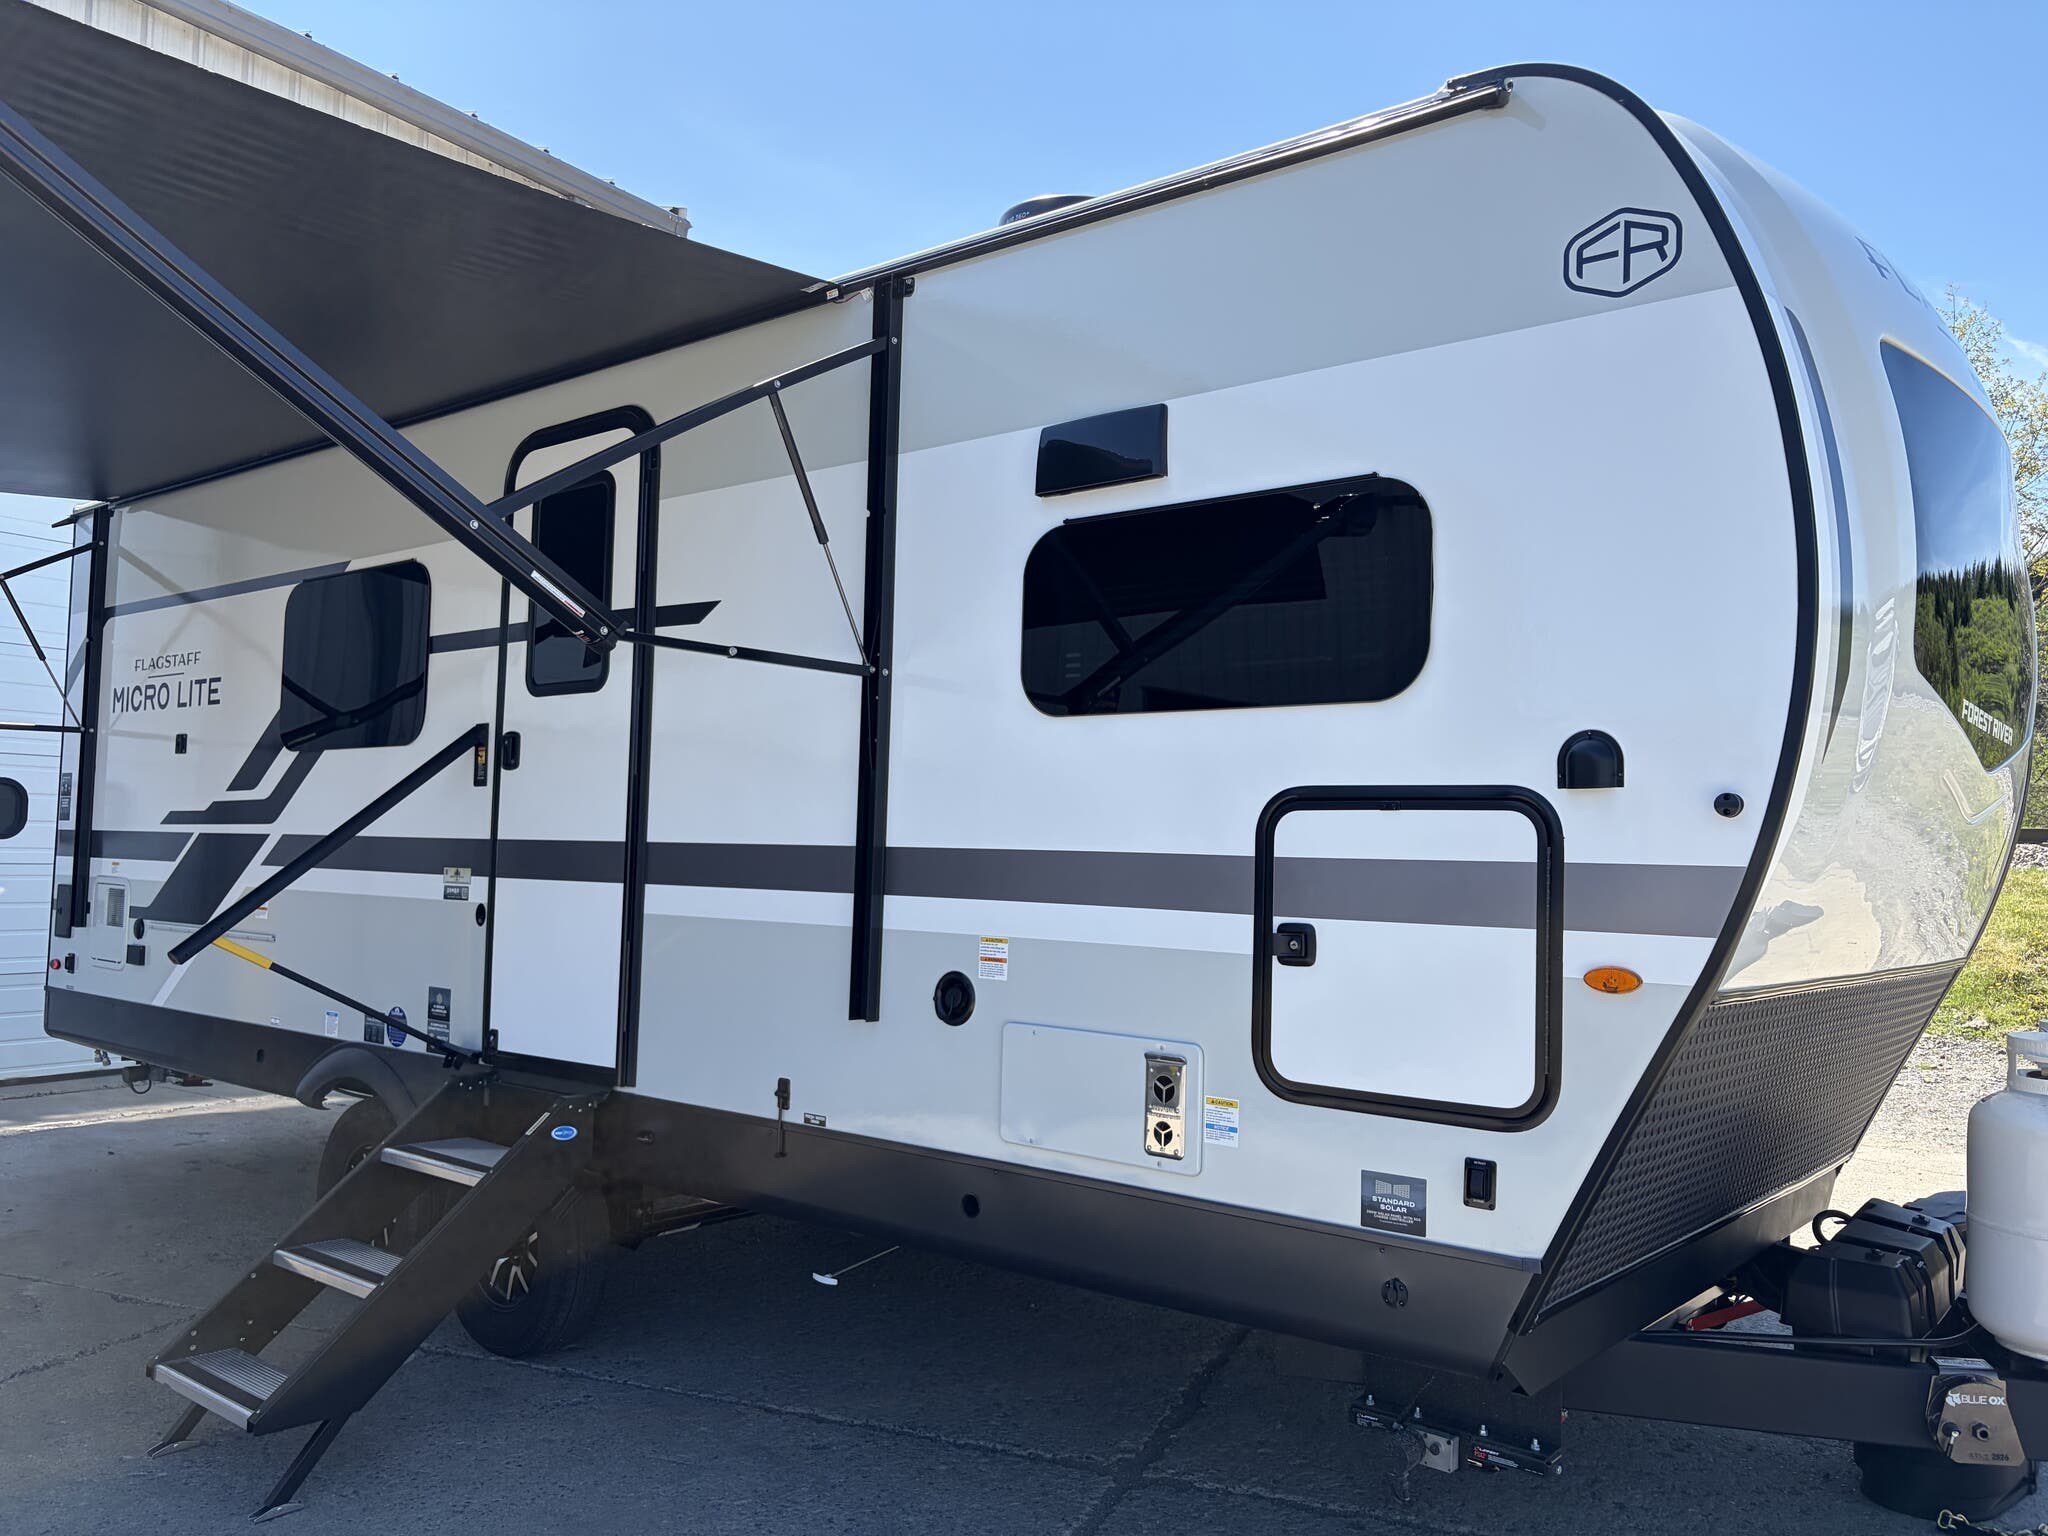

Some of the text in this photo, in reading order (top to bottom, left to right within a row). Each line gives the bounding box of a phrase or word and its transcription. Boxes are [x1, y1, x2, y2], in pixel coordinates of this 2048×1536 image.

[1575, 219, 1669, 285] FR
[134, 651, 201, 671] FLAGSTAFF
[112, 677, 222, 713] MICRO LITE
[1961, 698, 2014, 746] FOREST RIVER
[1372, 1195, 1416, 1208] STANDARD
[1380, 1203, 1407, 1213] SOLAR
[1961, 1394, 2006, 1406] BLUE OX
